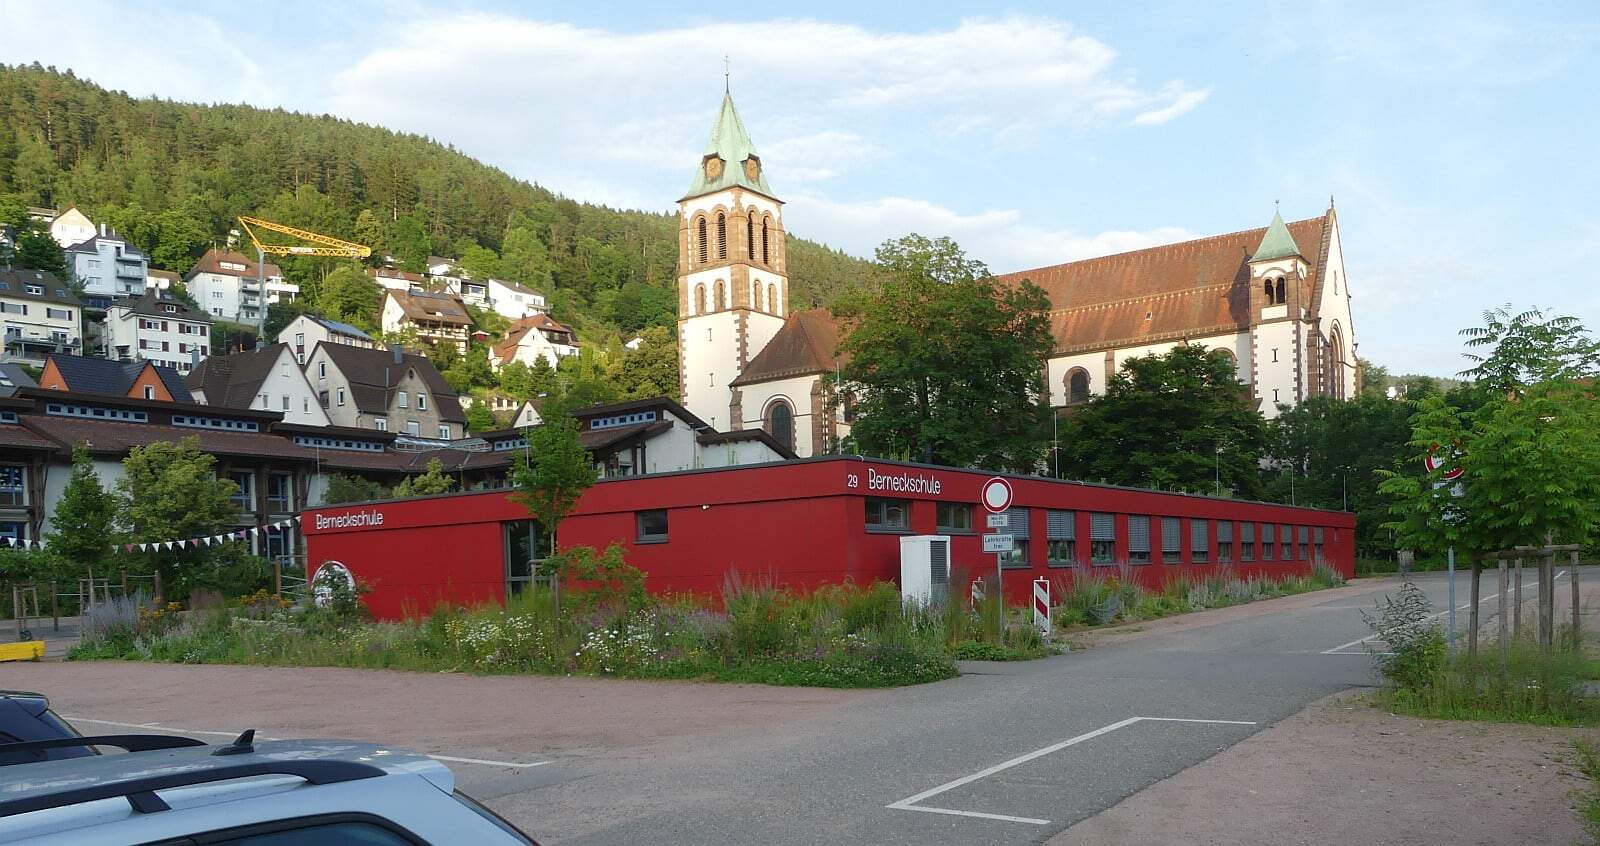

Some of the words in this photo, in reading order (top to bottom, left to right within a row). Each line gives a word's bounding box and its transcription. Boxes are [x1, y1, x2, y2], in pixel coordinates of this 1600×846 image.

[847, 474, 858, 488] 29
[868, 468, 941, 494] Berneckschule
[315, 509, 384, 530] Berneckschule
